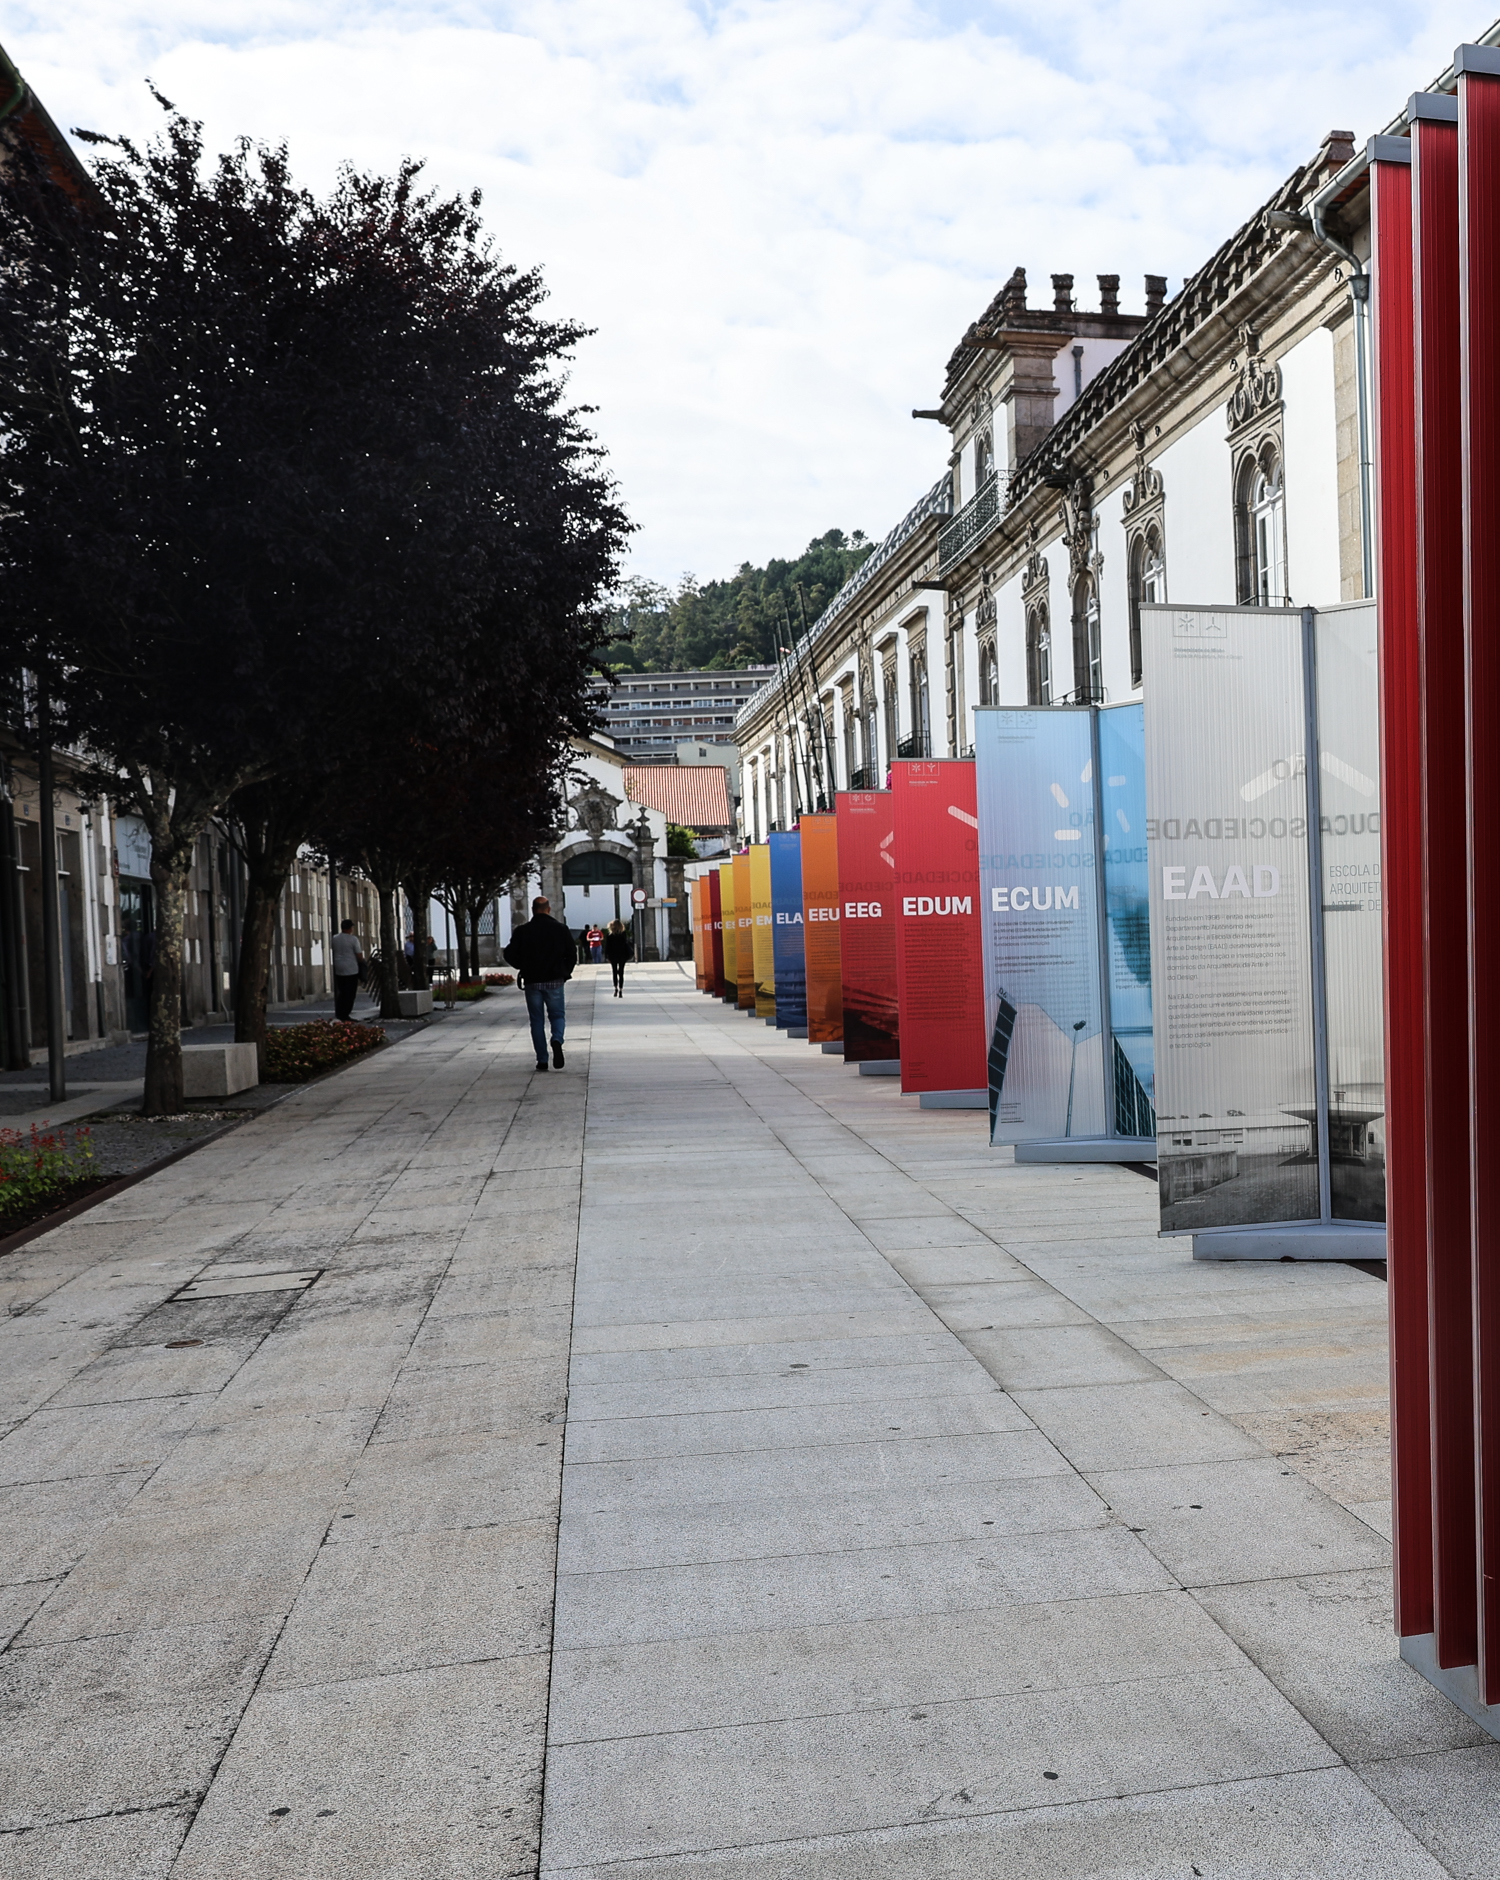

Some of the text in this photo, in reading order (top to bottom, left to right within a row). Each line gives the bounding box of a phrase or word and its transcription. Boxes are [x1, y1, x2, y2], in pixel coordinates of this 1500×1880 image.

[1329, 864, 1370, 878] ESCOLA
[1163, 865, 1280, 900] EAAD
[903, 896, 972, 916] EDUM
[992, 886, 1079, 912] ECUM
[845, 902, 882, 918] EEG
